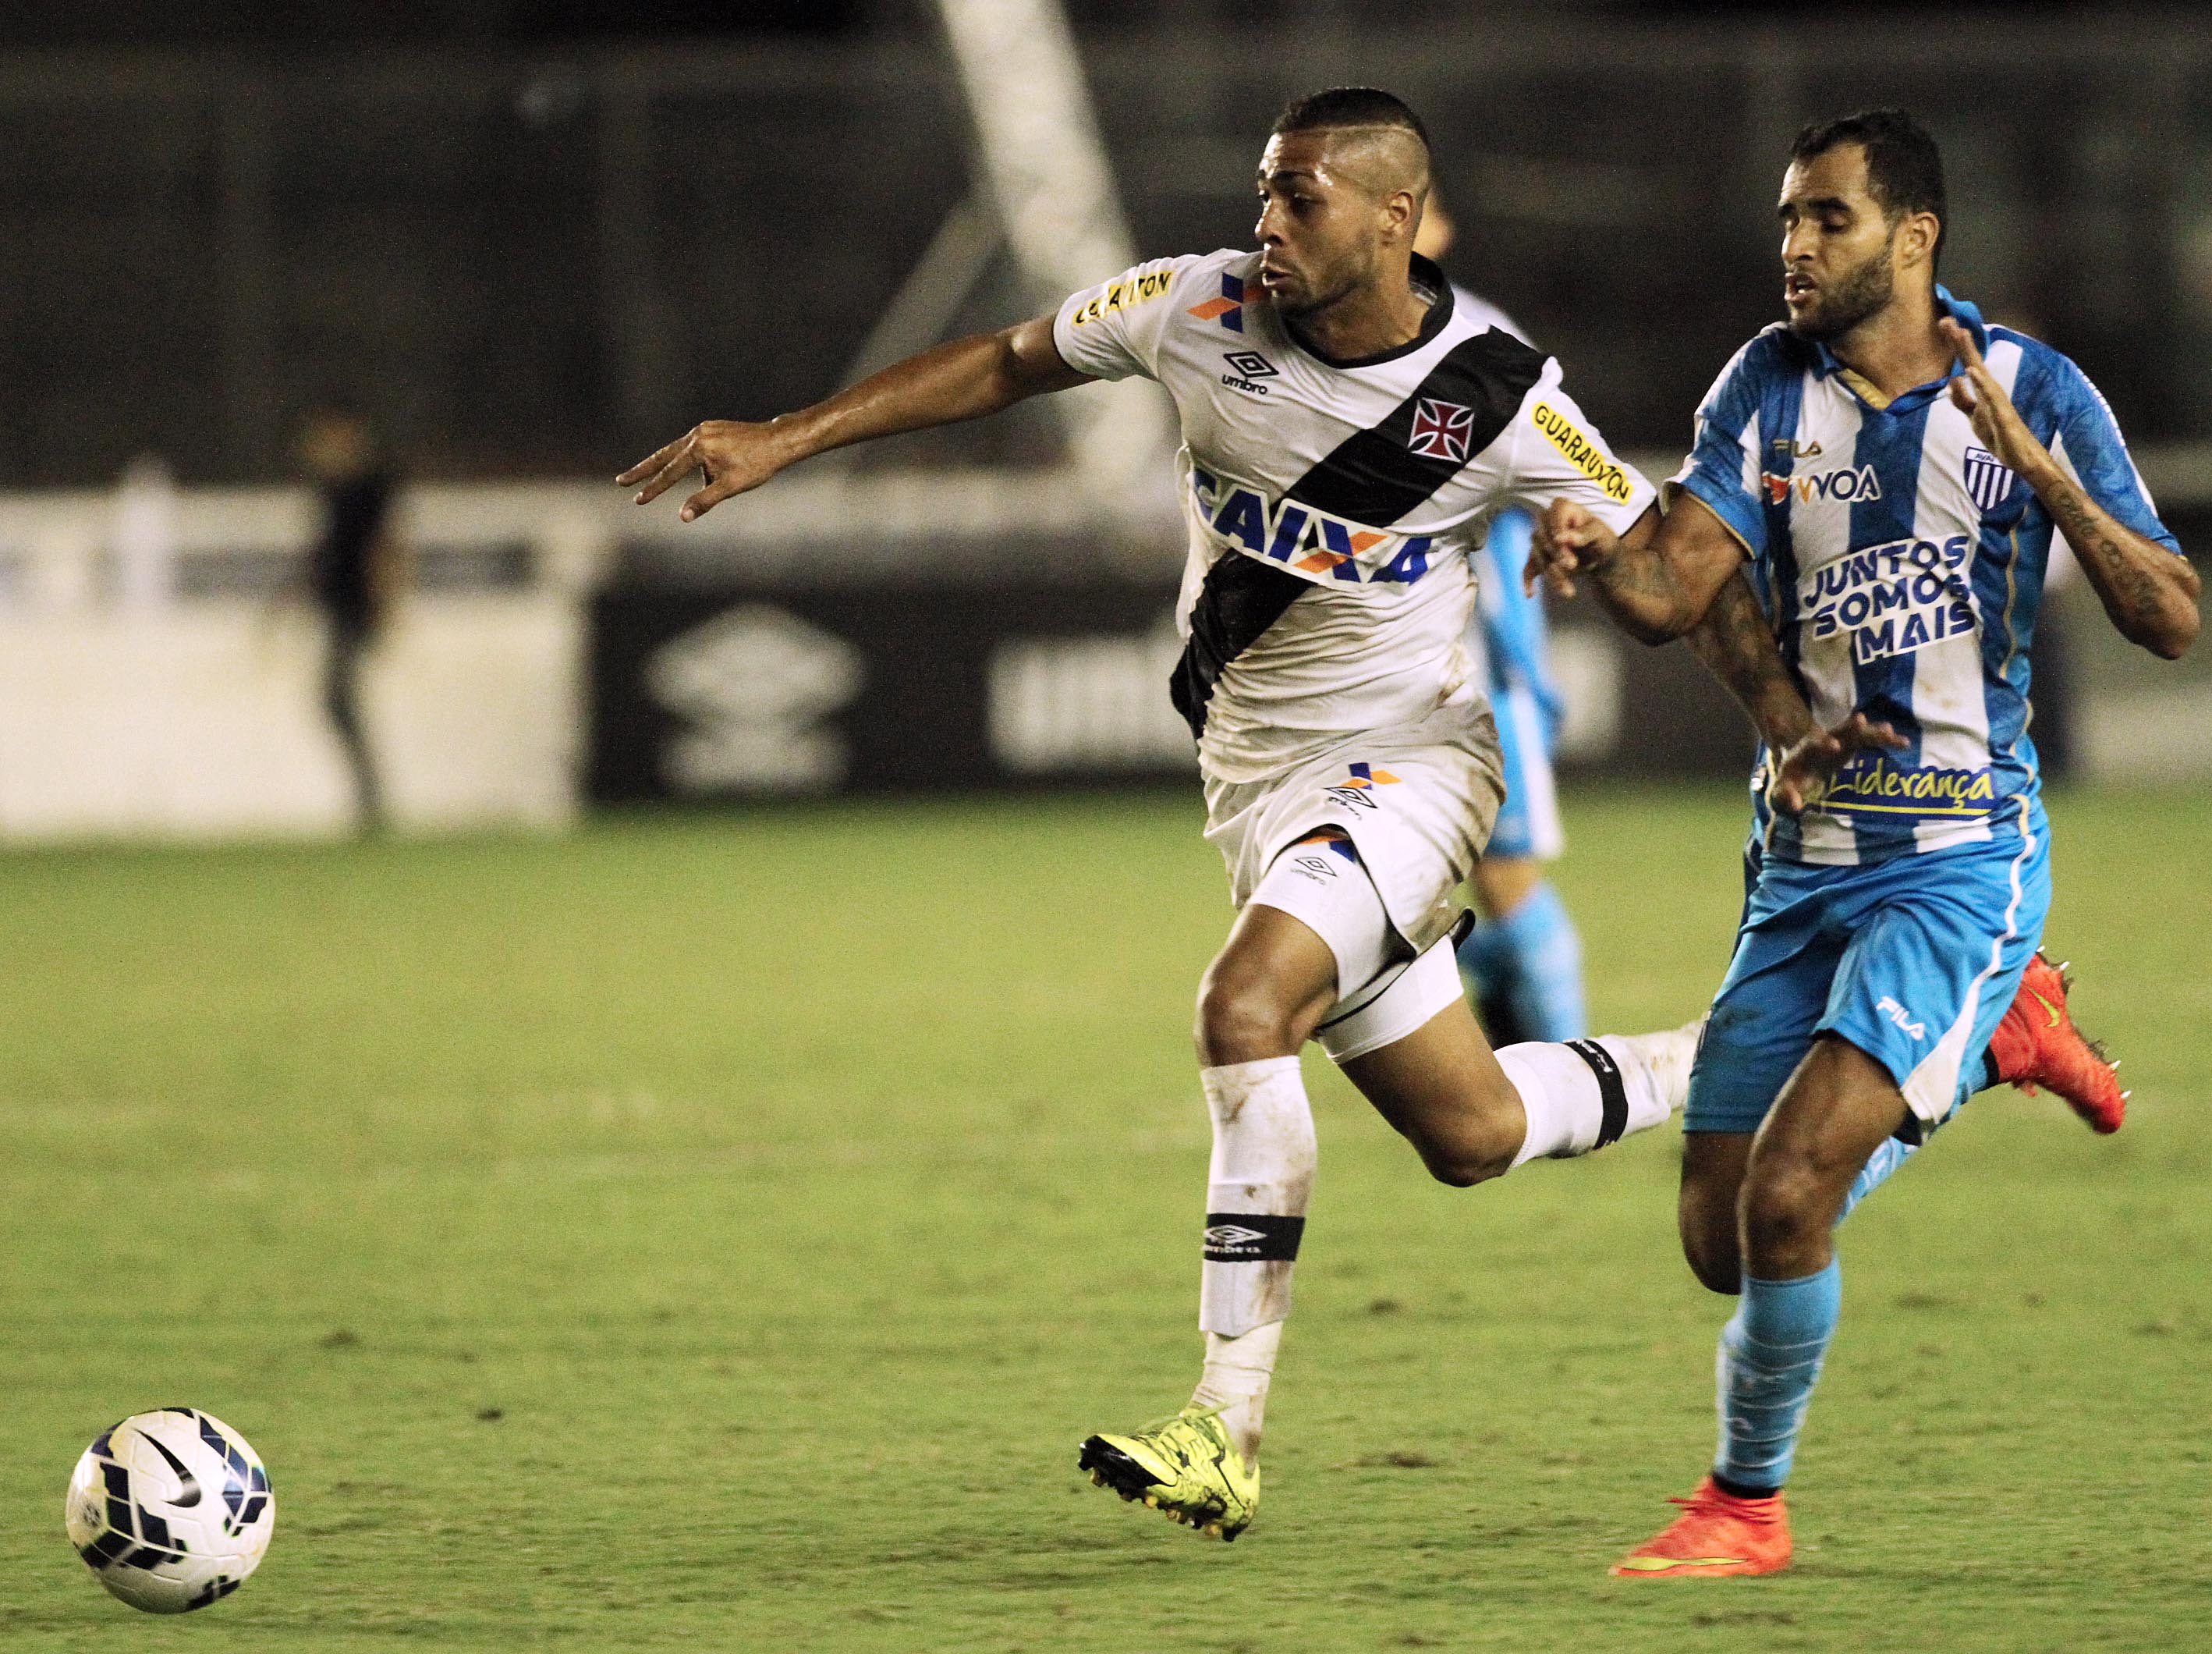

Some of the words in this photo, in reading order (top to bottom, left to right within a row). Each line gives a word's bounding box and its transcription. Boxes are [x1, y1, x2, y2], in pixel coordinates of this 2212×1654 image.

[1222, 374, 1267, 395] umbro
[1194, 470, 1432, 586] CAIXA
[1804, 536, 1969, 608] JUNTOS
[1812, 571, 1971, 637] SOMOS
[1859, 601, 1976, 660] MAIS
[1829, 758, 1994, 809] Liderança
[1876, 996, 1925, 1041] FILA
